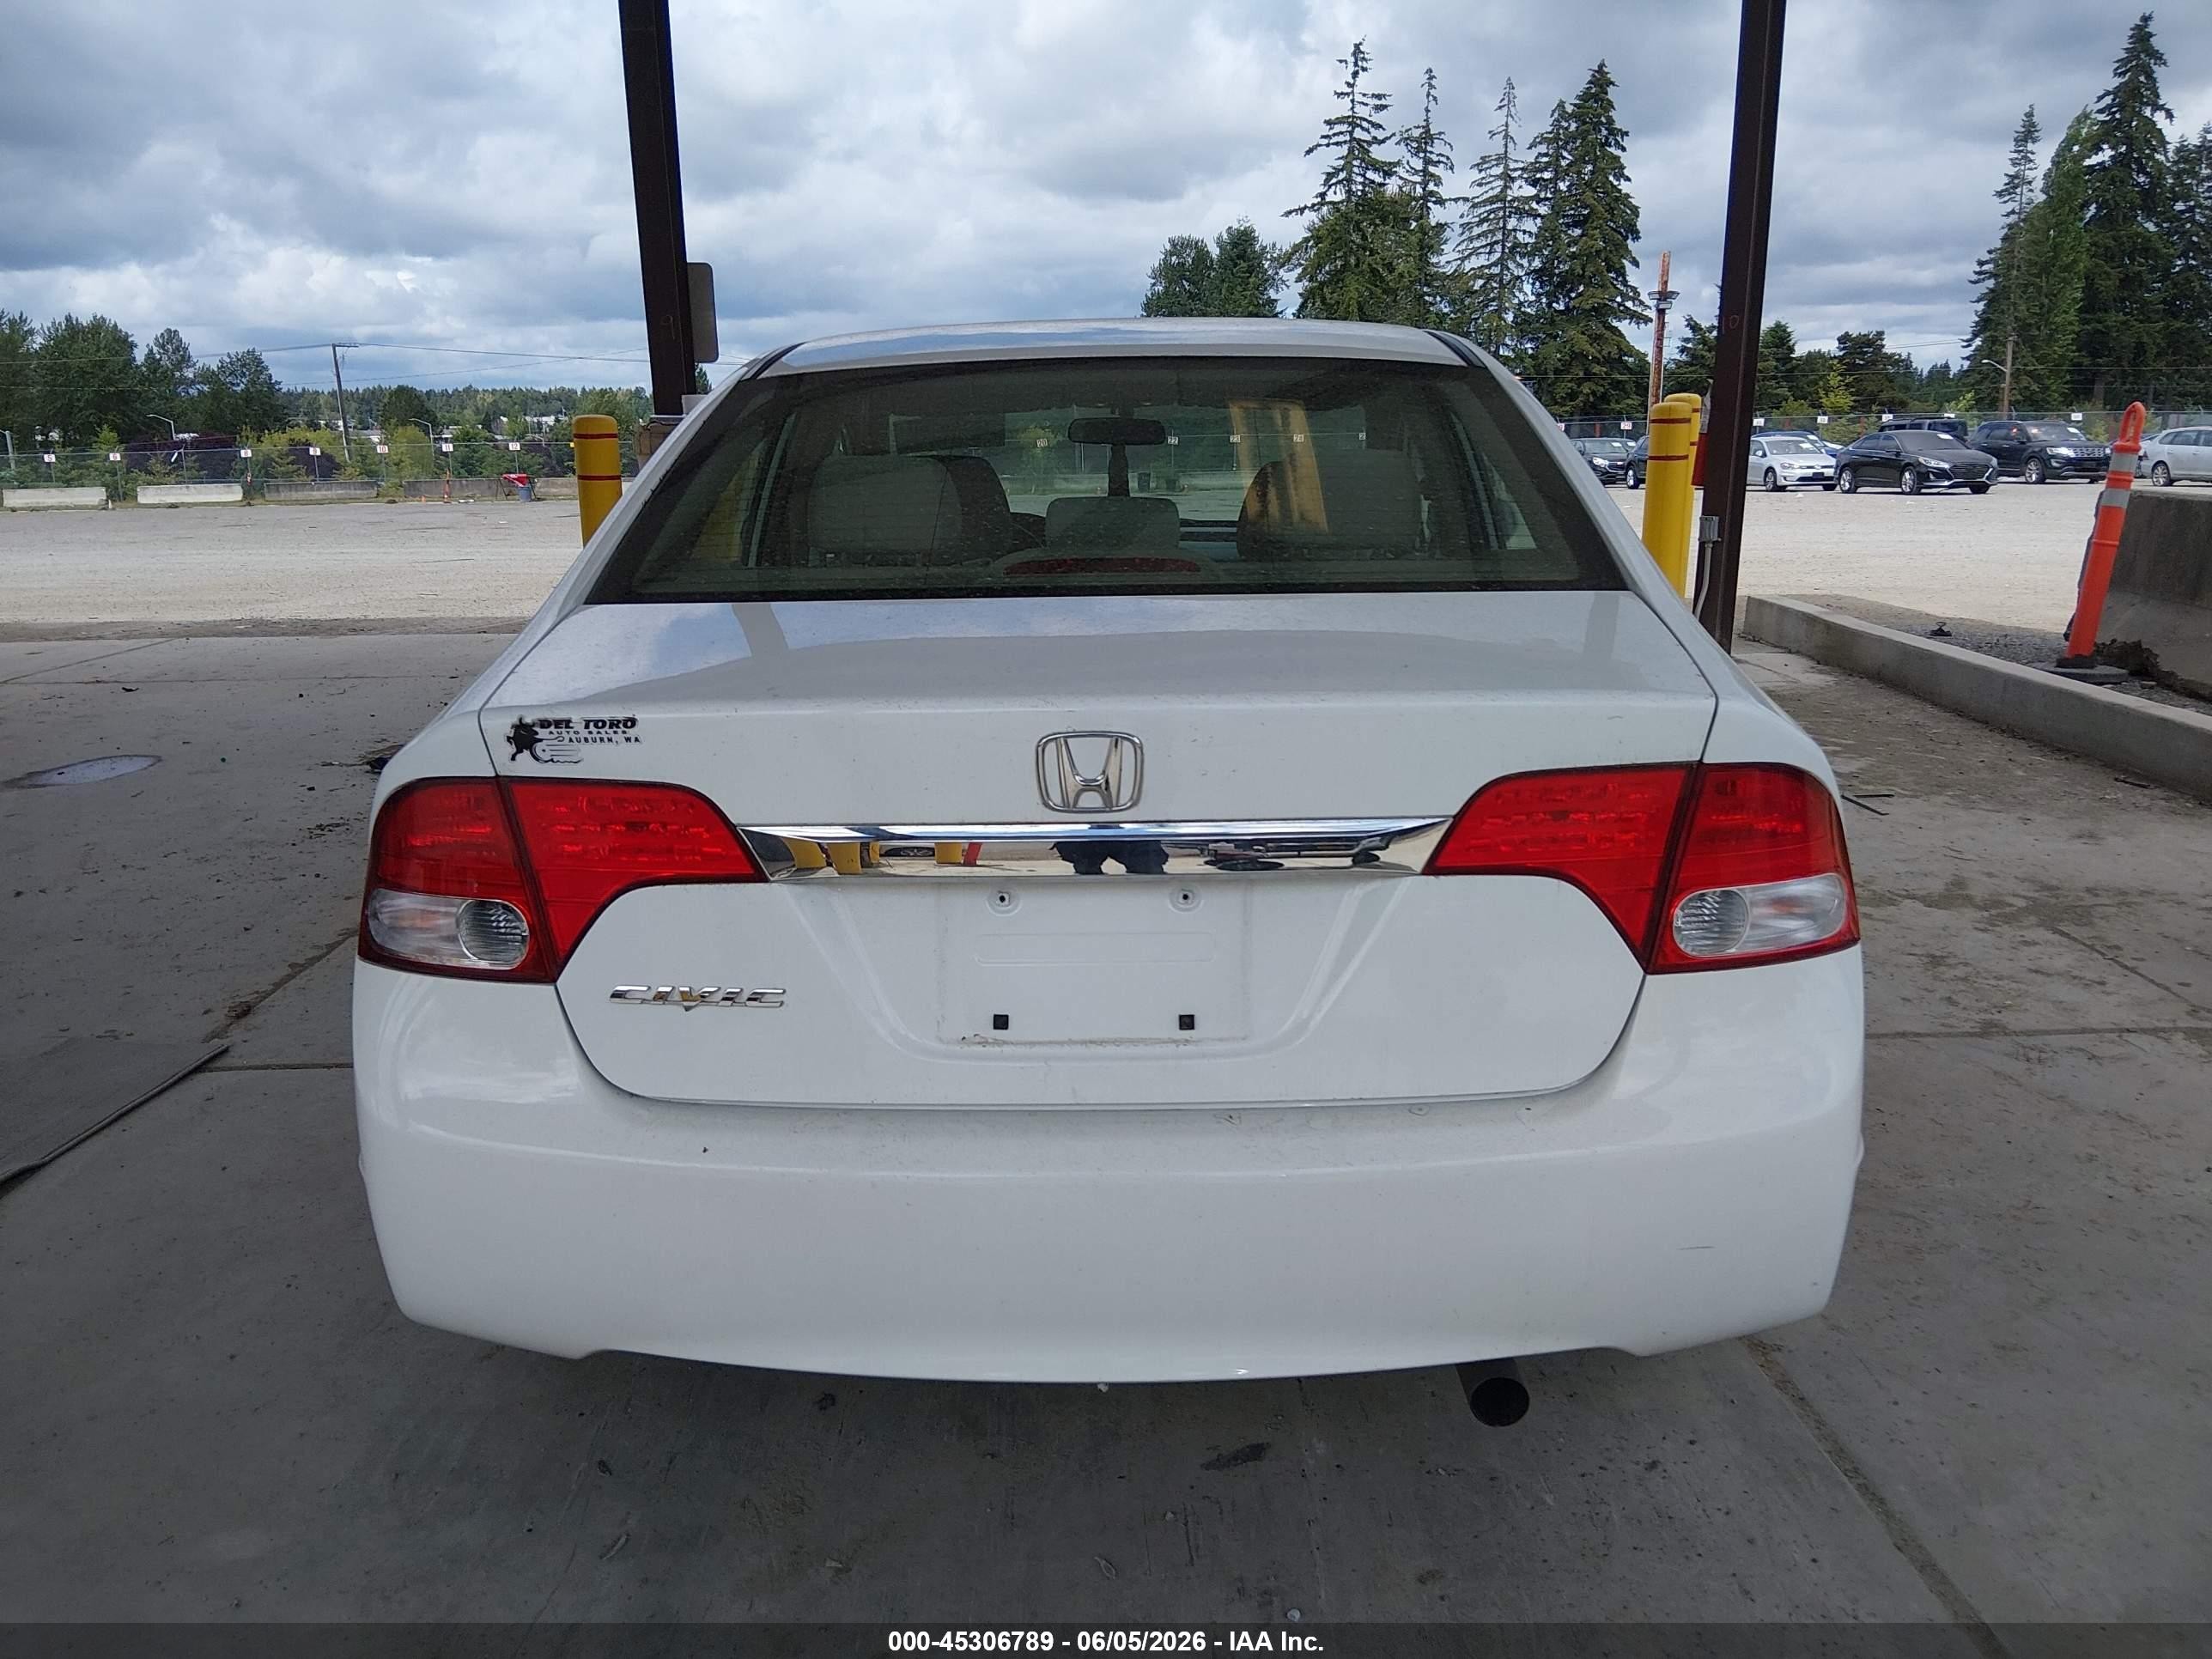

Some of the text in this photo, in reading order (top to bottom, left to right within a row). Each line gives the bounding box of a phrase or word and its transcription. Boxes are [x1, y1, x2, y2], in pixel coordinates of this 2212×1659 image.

[538, 717, 638, 730] DEL TORO
[568, 736, 619, 744] AUBURN,
[610, 985, 787, 1012] CIVIC
